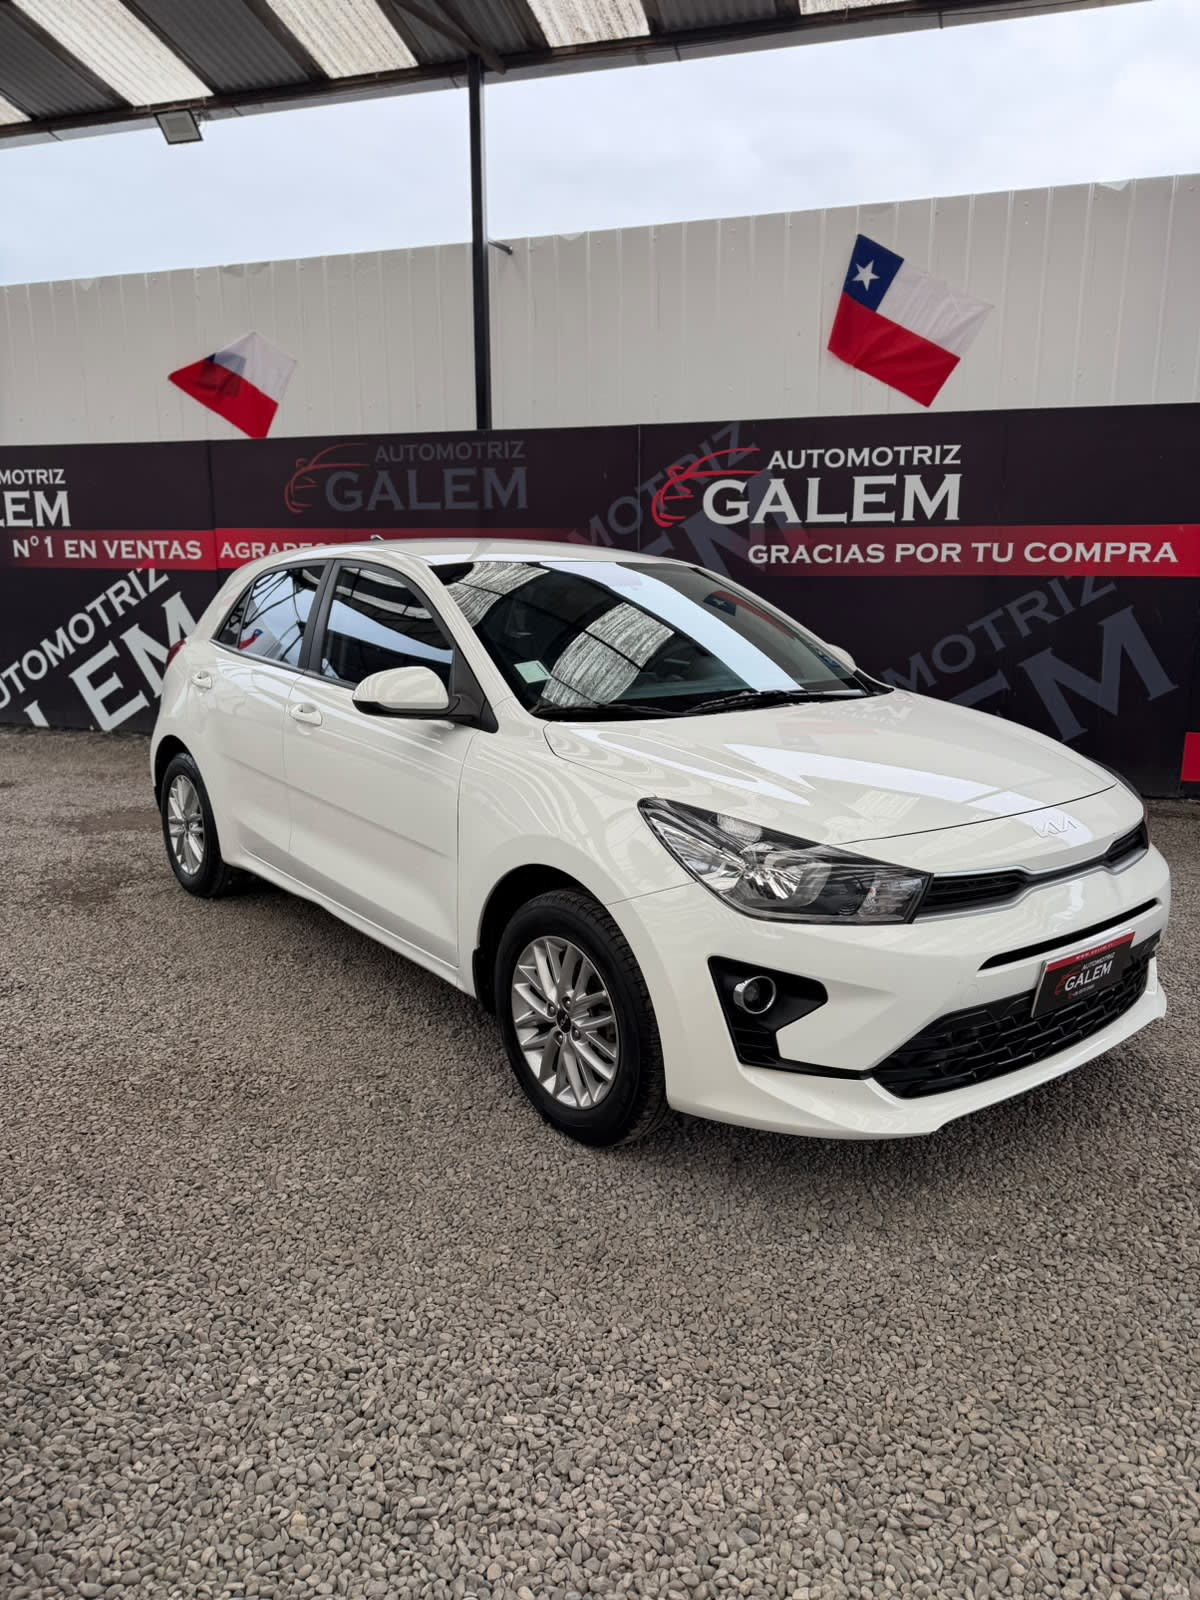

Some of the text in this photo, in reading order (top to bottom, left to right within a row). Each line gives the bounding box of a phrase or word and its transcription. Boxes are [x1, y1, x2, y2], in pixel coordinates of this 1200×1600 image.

[375, 440, 526, 462] AUTOMOTRIZ
[767, 444, 962, 470] AUTOMOTRIZ
[325, 466, 529, 512] GALEM
[702, 473, 962, 525] GALEM
[0, 490, 71, 528] EM
[64, 540, 97, 559] EN
[102, 540, 203, 560] VENTAS
[748, 542, 1178, 564] GRACIAS POR TU COMPRA
[1064, 960, 1113, 991] GALEM
